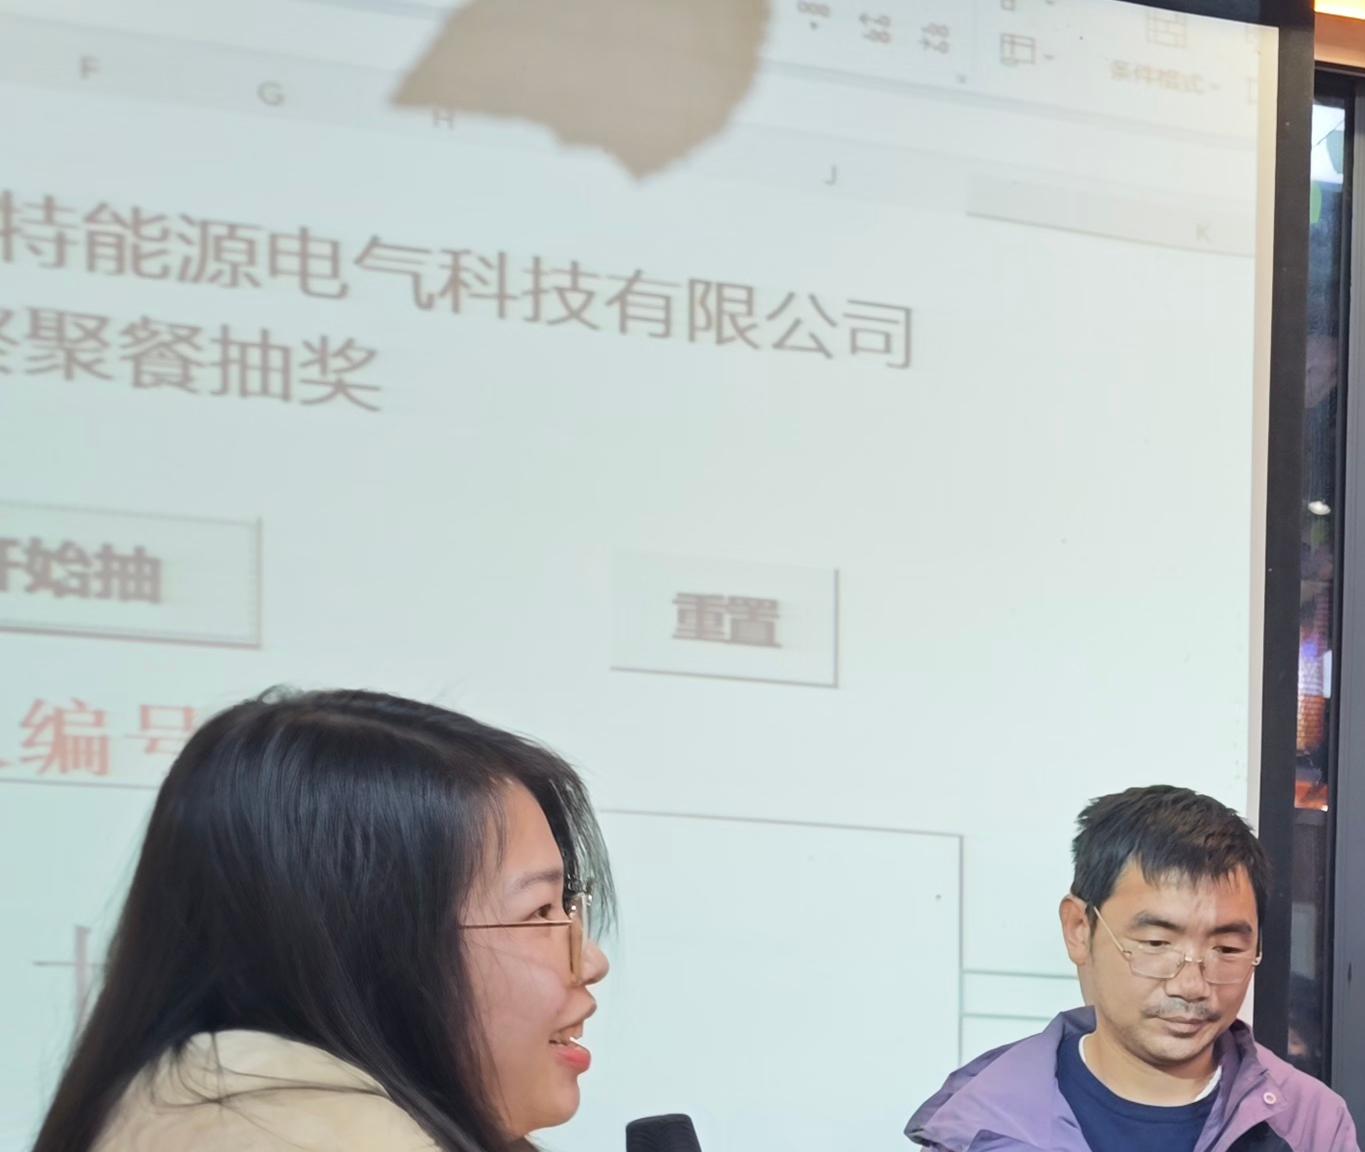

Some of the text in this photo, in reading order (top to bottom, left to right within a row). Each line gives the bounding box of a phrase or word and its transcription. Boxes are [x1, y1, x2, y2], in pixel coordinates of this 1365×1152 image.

[257, 81, 286, 106] G
[825, 165, 838, 187] J
[0, 189, 914, 370] 特能源电气科技有限公司
[672, 591, 783, 649] 重置
[0, 697, 202, 777] 编号
